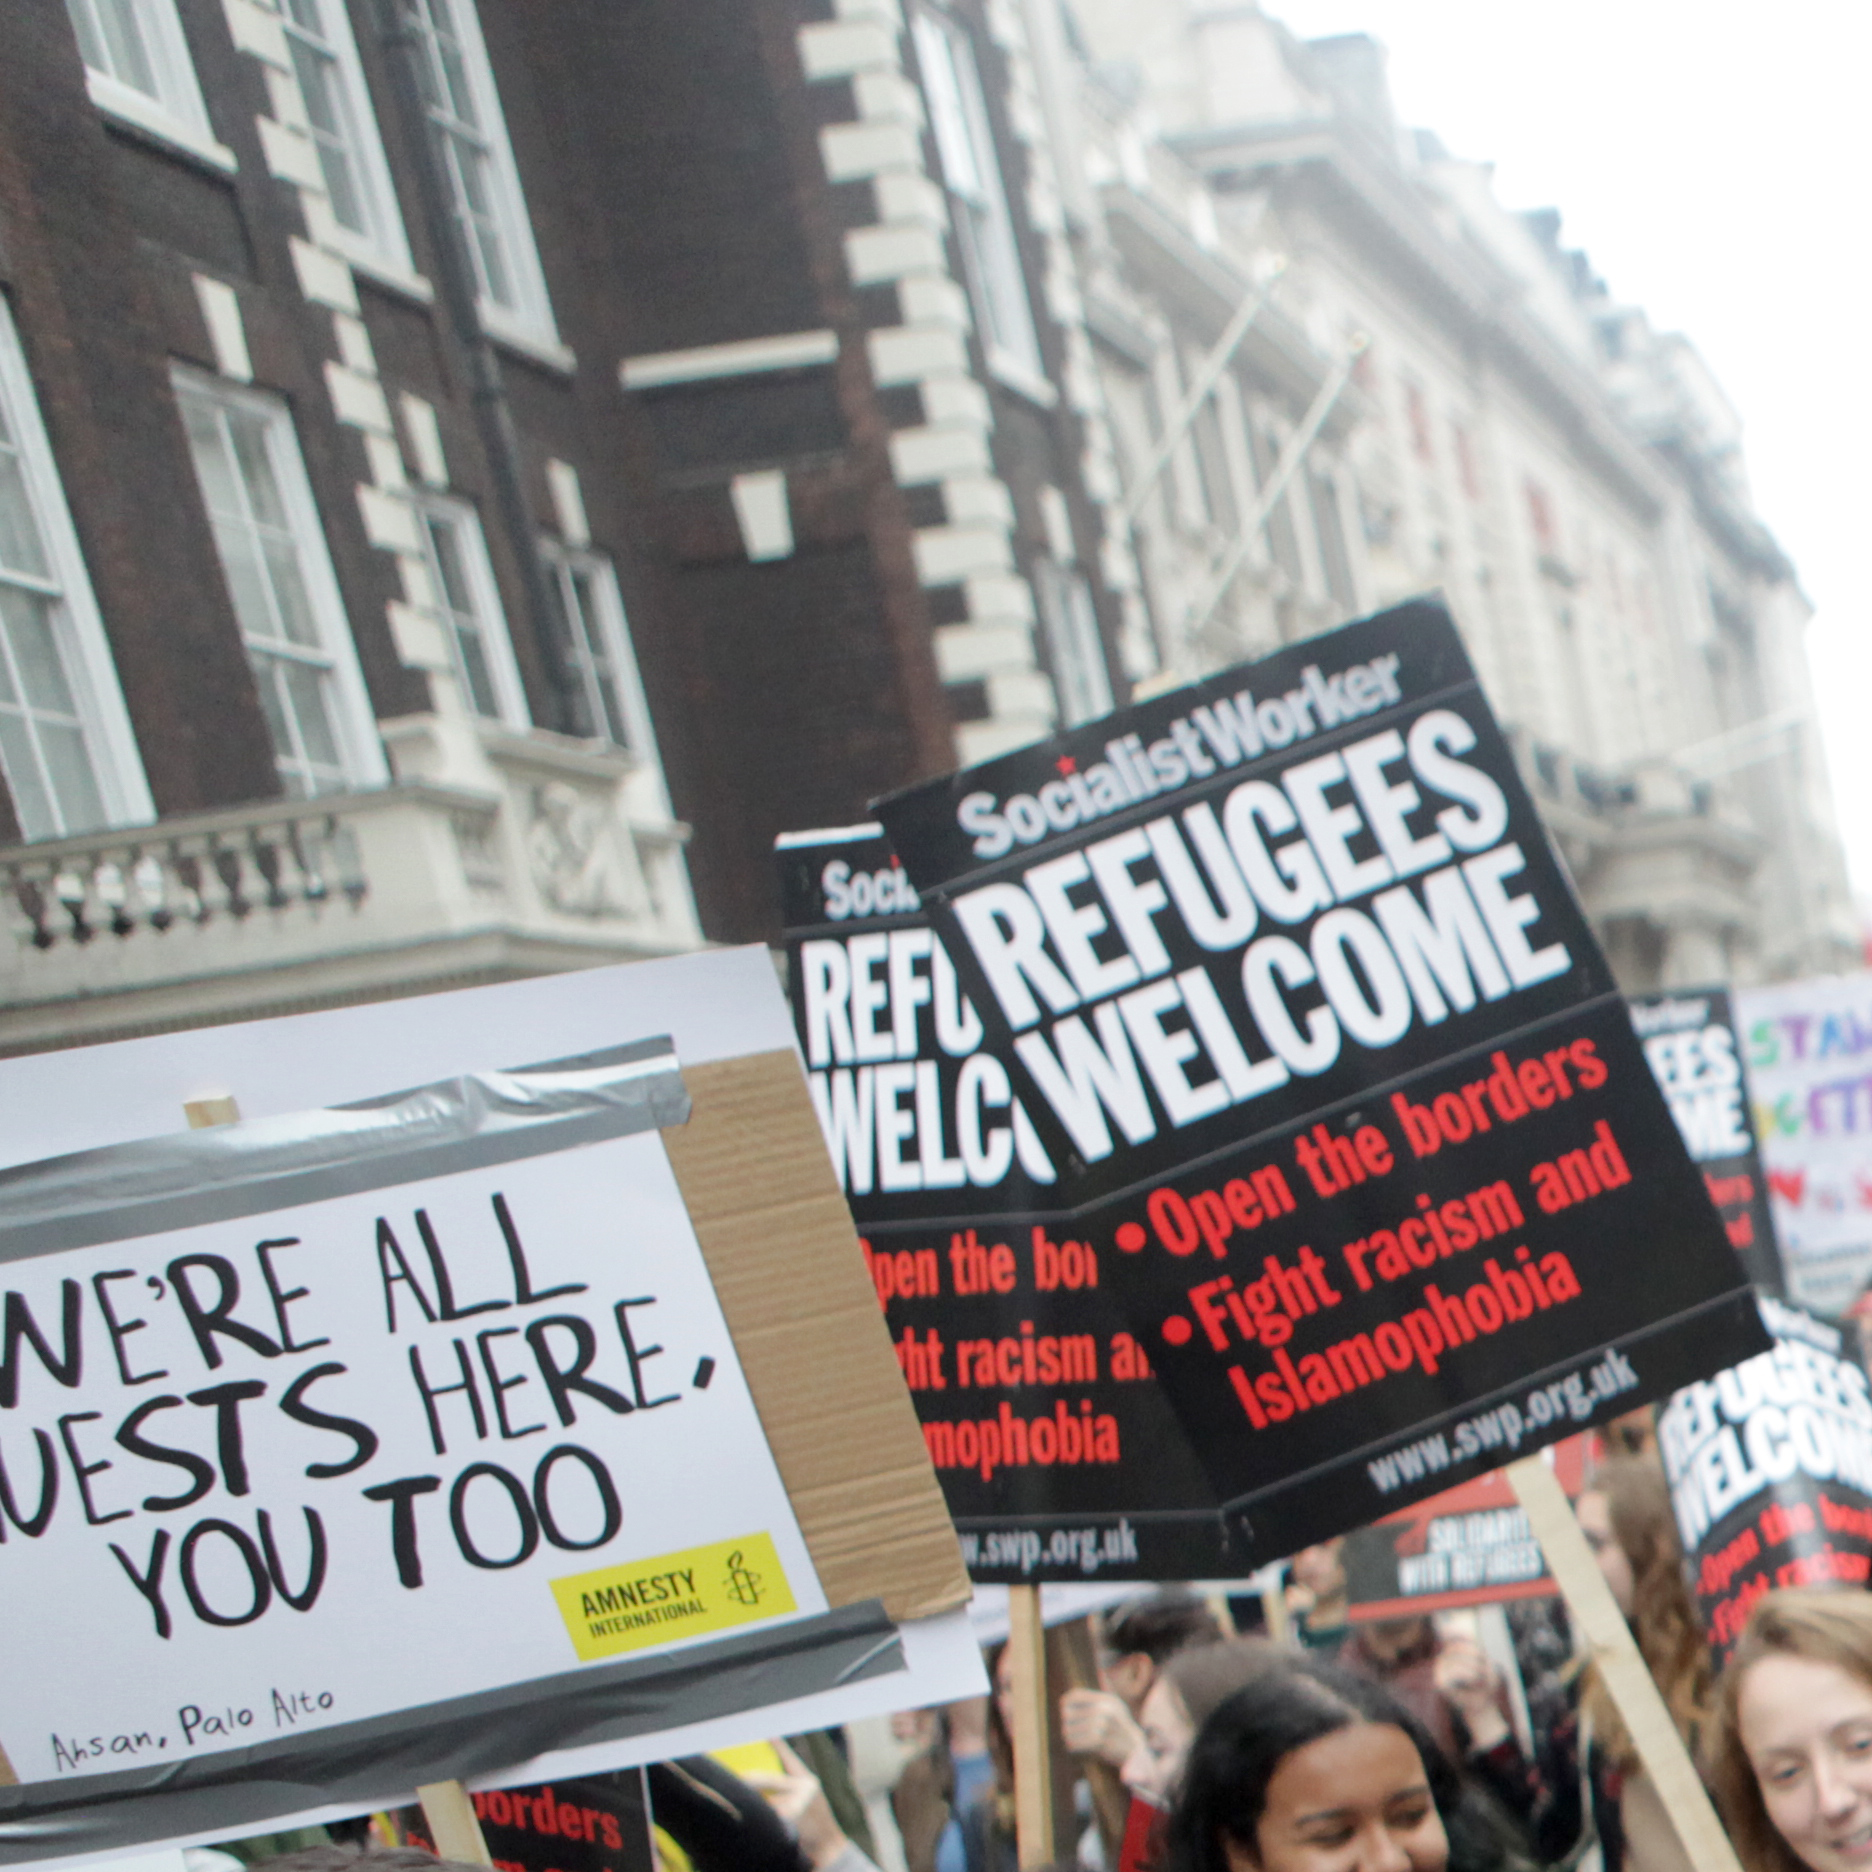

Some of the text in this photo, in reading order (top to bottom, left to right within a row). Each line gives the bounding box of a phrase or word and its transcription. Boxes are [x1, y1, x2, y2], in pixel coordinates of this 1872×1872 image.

[952, 708, 1509, 1032] REFUGEES
[1014, 842, 1574, 1164] WELCOME
[1147, 1163, 1297, 1260] Open
[1294, 1122, 1394, 1197] the
[1391, 1037, 1608, 1159] borders
[376, 1191, 590, 1334] ALL
[948, 1228, 1016, 1295] the
[1188, 1244, 1342, 1353] Fight
[1342, 1194, 1524, 1294] racism
[1529, 1119, 1632, 1214] and
[0, 1296, 716, 1544] UESTS HERE,
[956, 1320, 1097, 1388] racism
[1227, 1246, 1582, 1431] Islamophobia
[1368, 1347, 1638, 1492] www.swp.org.uk
[107, 1444, 622, 1640] YOU TOO
[580, 1568, 697, 1619] AMNESTY
[588, 1598, 708, 1639] INTERNATIONAL
[179, 1705, 254, 1745] Palo
[271, 1687, 335, 1728] Alto
